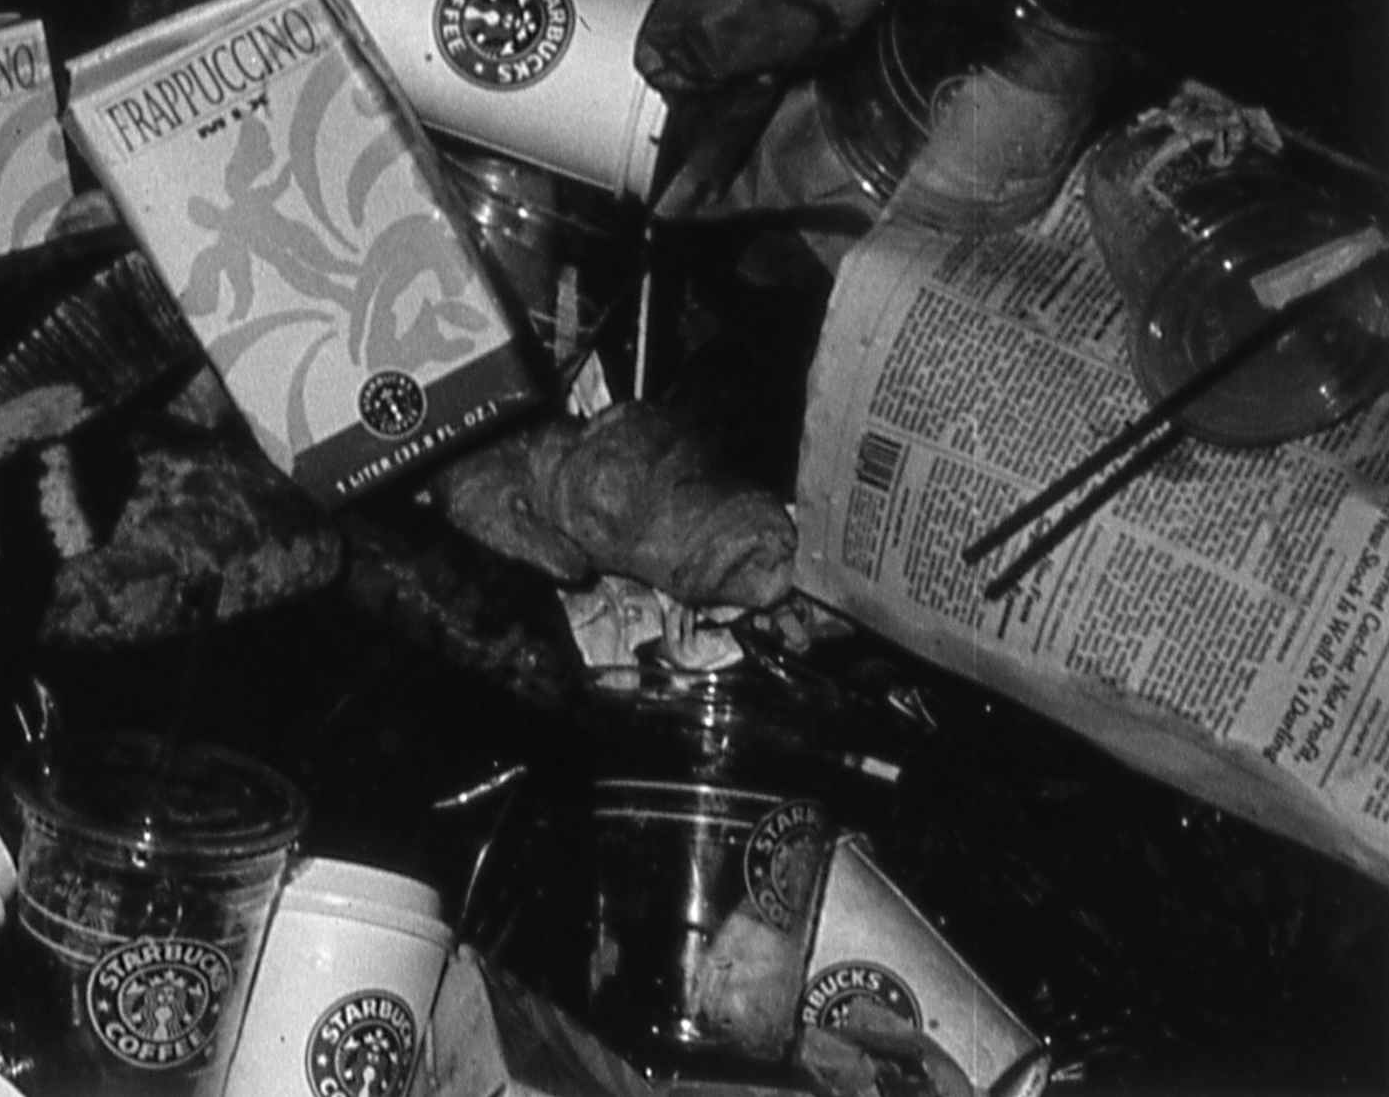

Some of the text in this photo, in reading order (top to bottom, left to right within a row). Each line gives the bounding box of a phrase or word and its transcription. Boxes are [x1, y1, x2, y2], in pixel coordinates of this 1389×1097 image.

[108, 8, 316, 152] FRAPPUCCINO
[1315, 616, 1351, 665] Wall
[1262, 694, 1311, 765] Darling
